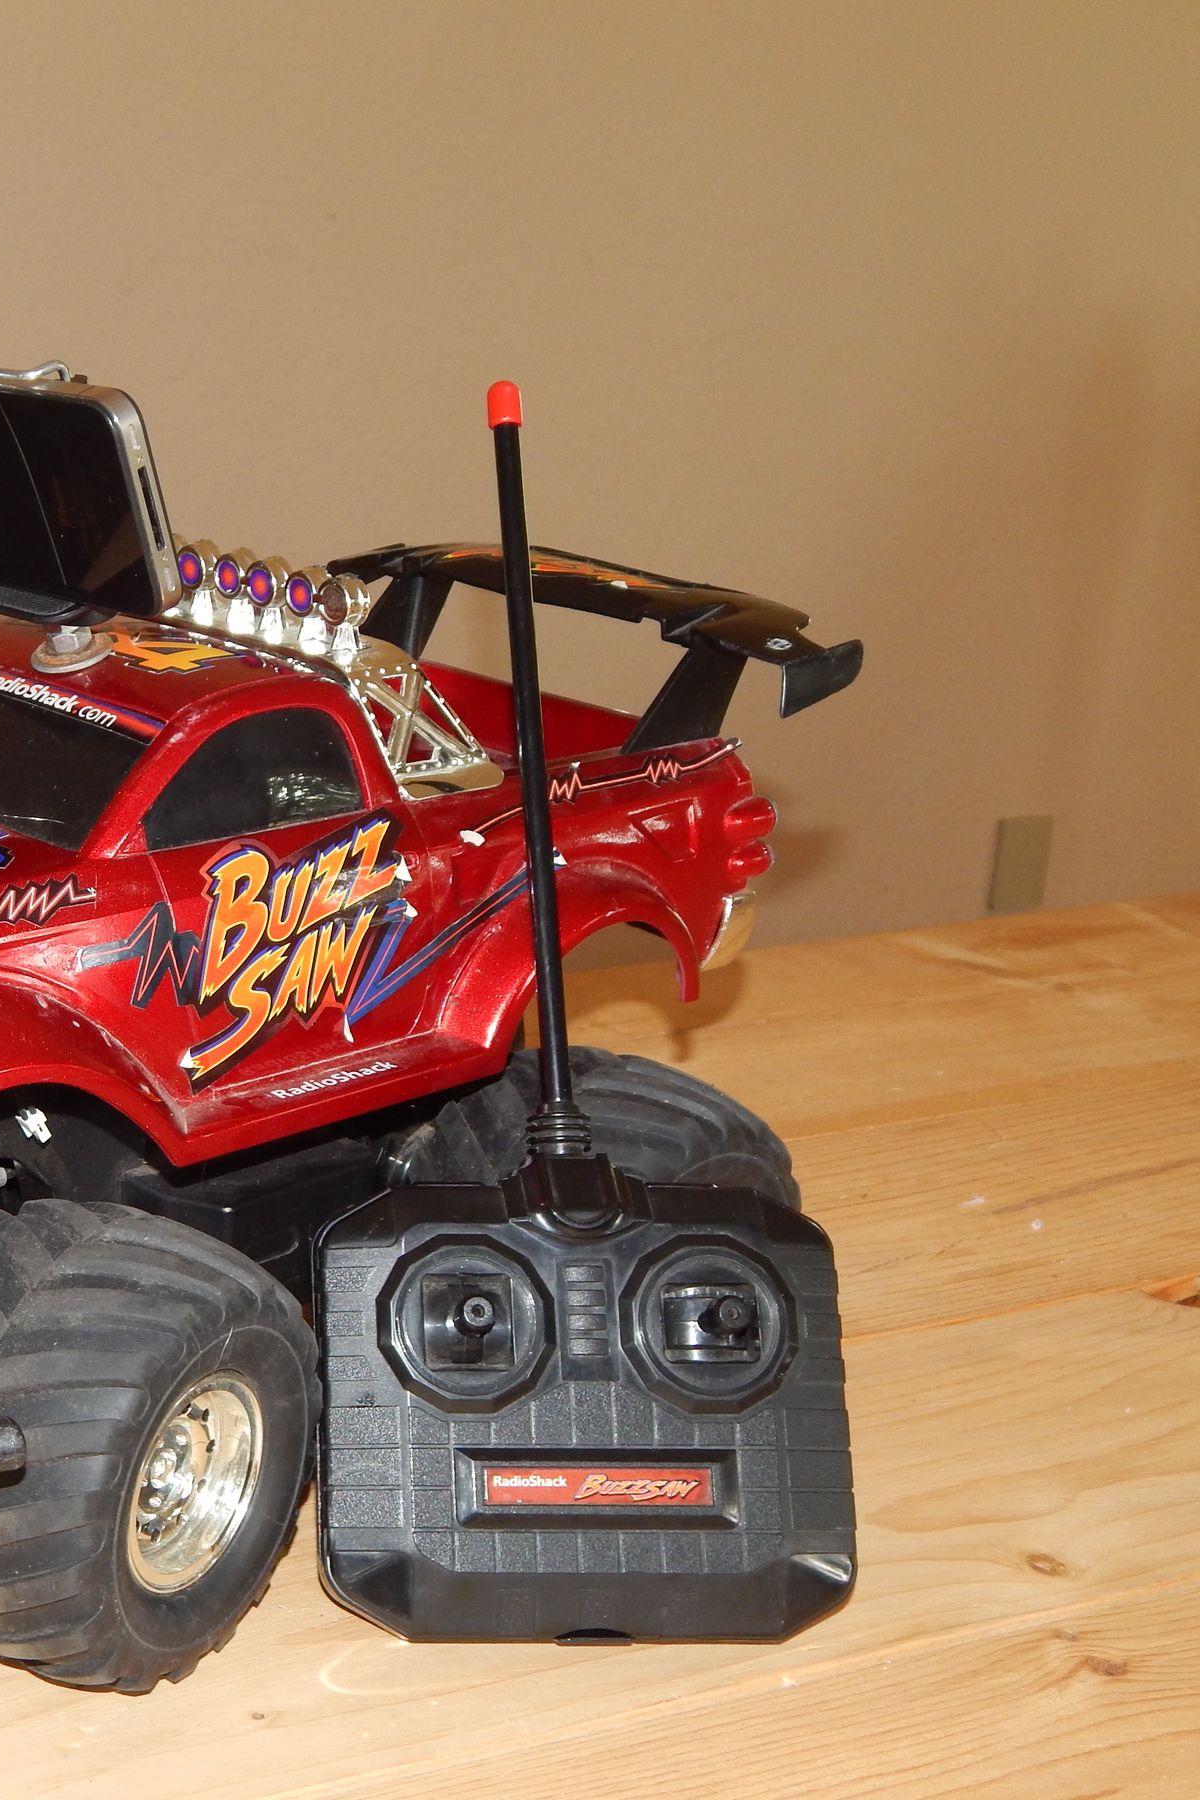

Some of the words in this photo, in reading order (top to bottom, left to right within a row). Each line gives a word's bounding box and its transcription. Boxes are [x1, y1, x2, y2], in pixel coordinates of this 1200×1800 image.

[200, 818, 398, 1005] BUZZ
[191, 906, 379, 1081] SAW
[271, 1061, 398, 1099] RadioShack
[493, 1475, 568, 1488] RadioShack
